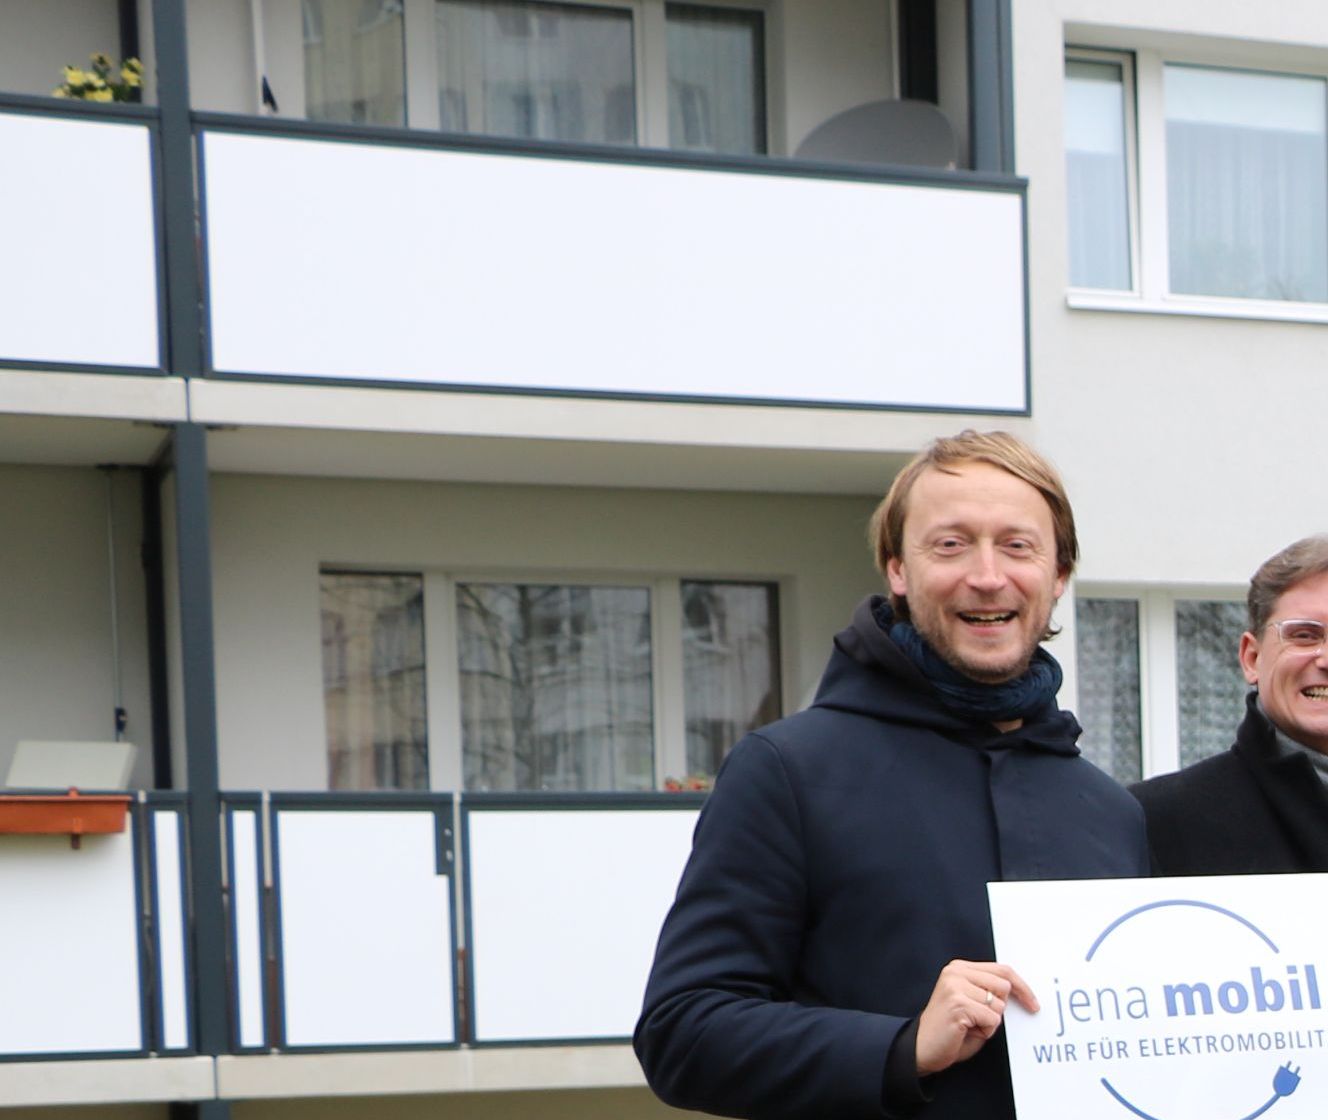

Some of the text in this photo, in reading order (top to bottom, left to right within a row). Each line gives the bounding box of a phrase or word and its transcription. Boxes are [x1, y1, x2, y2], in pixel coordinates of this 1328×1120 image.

[1053, 964, 1322, 1037] jena mobil
[1033, 1042, 1077, 1064] WIR
[1087, 1035, 1129, 1061] FÜR
